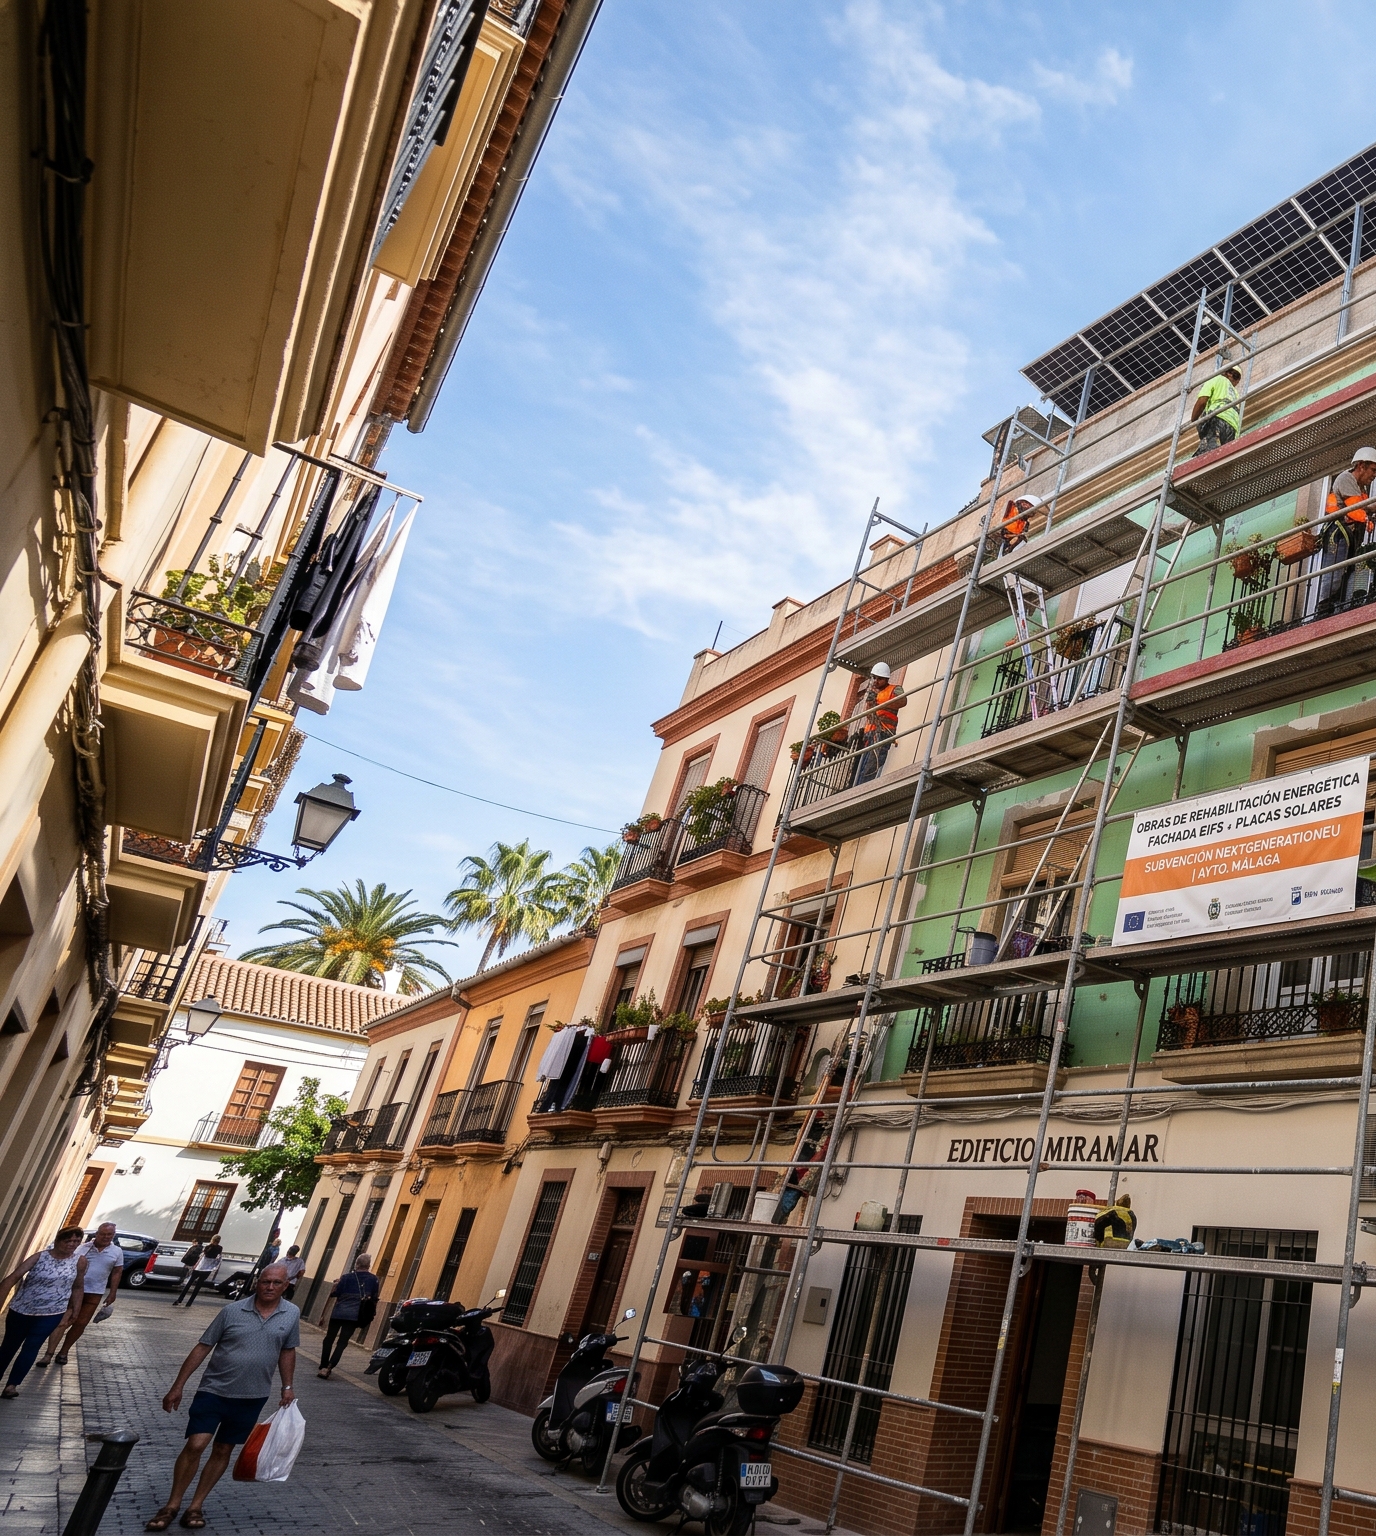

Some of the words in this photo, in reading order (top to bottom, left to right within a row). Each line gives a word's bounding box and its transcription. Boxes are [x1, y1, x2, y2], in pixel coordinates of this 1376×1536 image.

[1136, 817, 1172, 833] OBRAS
[1173, 813, 1188, 826] DE
[1189, 790, 1281, 822] REHABILITACIÓN
[1282, 772, 1360, 801] ENERGÉTICA
[1147, 828, 1197, 847] FACHADA
[1199, 821, 1224, 836] EIFS
[1235, 808, 1281, 829] PLACAS
[1283, 795, 1342, 819] SOLARES
[1144, 849, 1214, 873] SUBVENCIÓN
[1215, 823, 1341, 859] NEXTGENERATIONEU
[1231, 853, 1280, 872] MÁLAGA
[947, 1137, 1036, 1163] EDIFICIO
[1043, 1134, 1159, 1162] MIRAMAR
